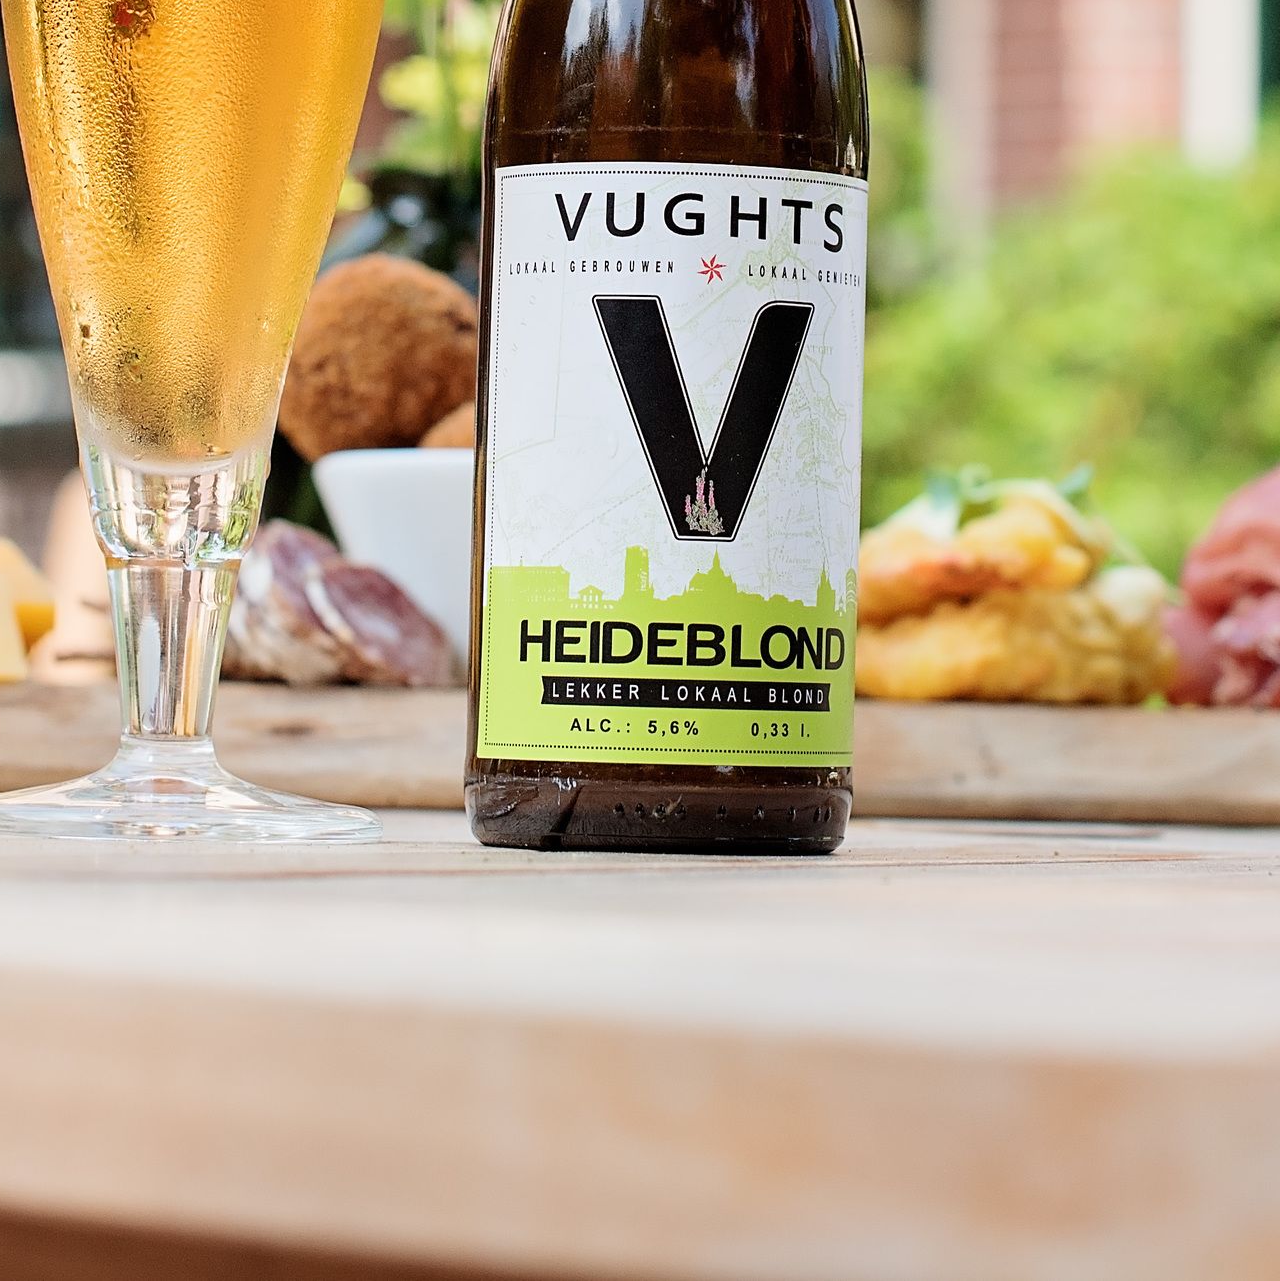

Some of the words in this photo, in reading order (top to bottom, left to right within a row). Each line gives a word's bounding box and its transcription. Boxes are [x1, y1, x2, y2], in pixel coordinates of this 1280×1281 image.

[554, 192, 843, 253] VUGHTS
[509, 261, 556, 276] LOKAAL
[569, 260, 674, 274] GEBROUWEN
[748, 264, 807, 281] LOKAAL
[591, 294, 816, 543] V
[519, 619, 845, 671] HEIDEBLOND
[552, 682, 640, 700] LEKKER
[661, 685, 752, 703] LOKAAL
[768, 688, 824, 704] BLOND
[570, 717, 632, 734] ALC.:
[647, 720, 699, 737] 5,6%
[750, 722, 789, 740] 0,33
